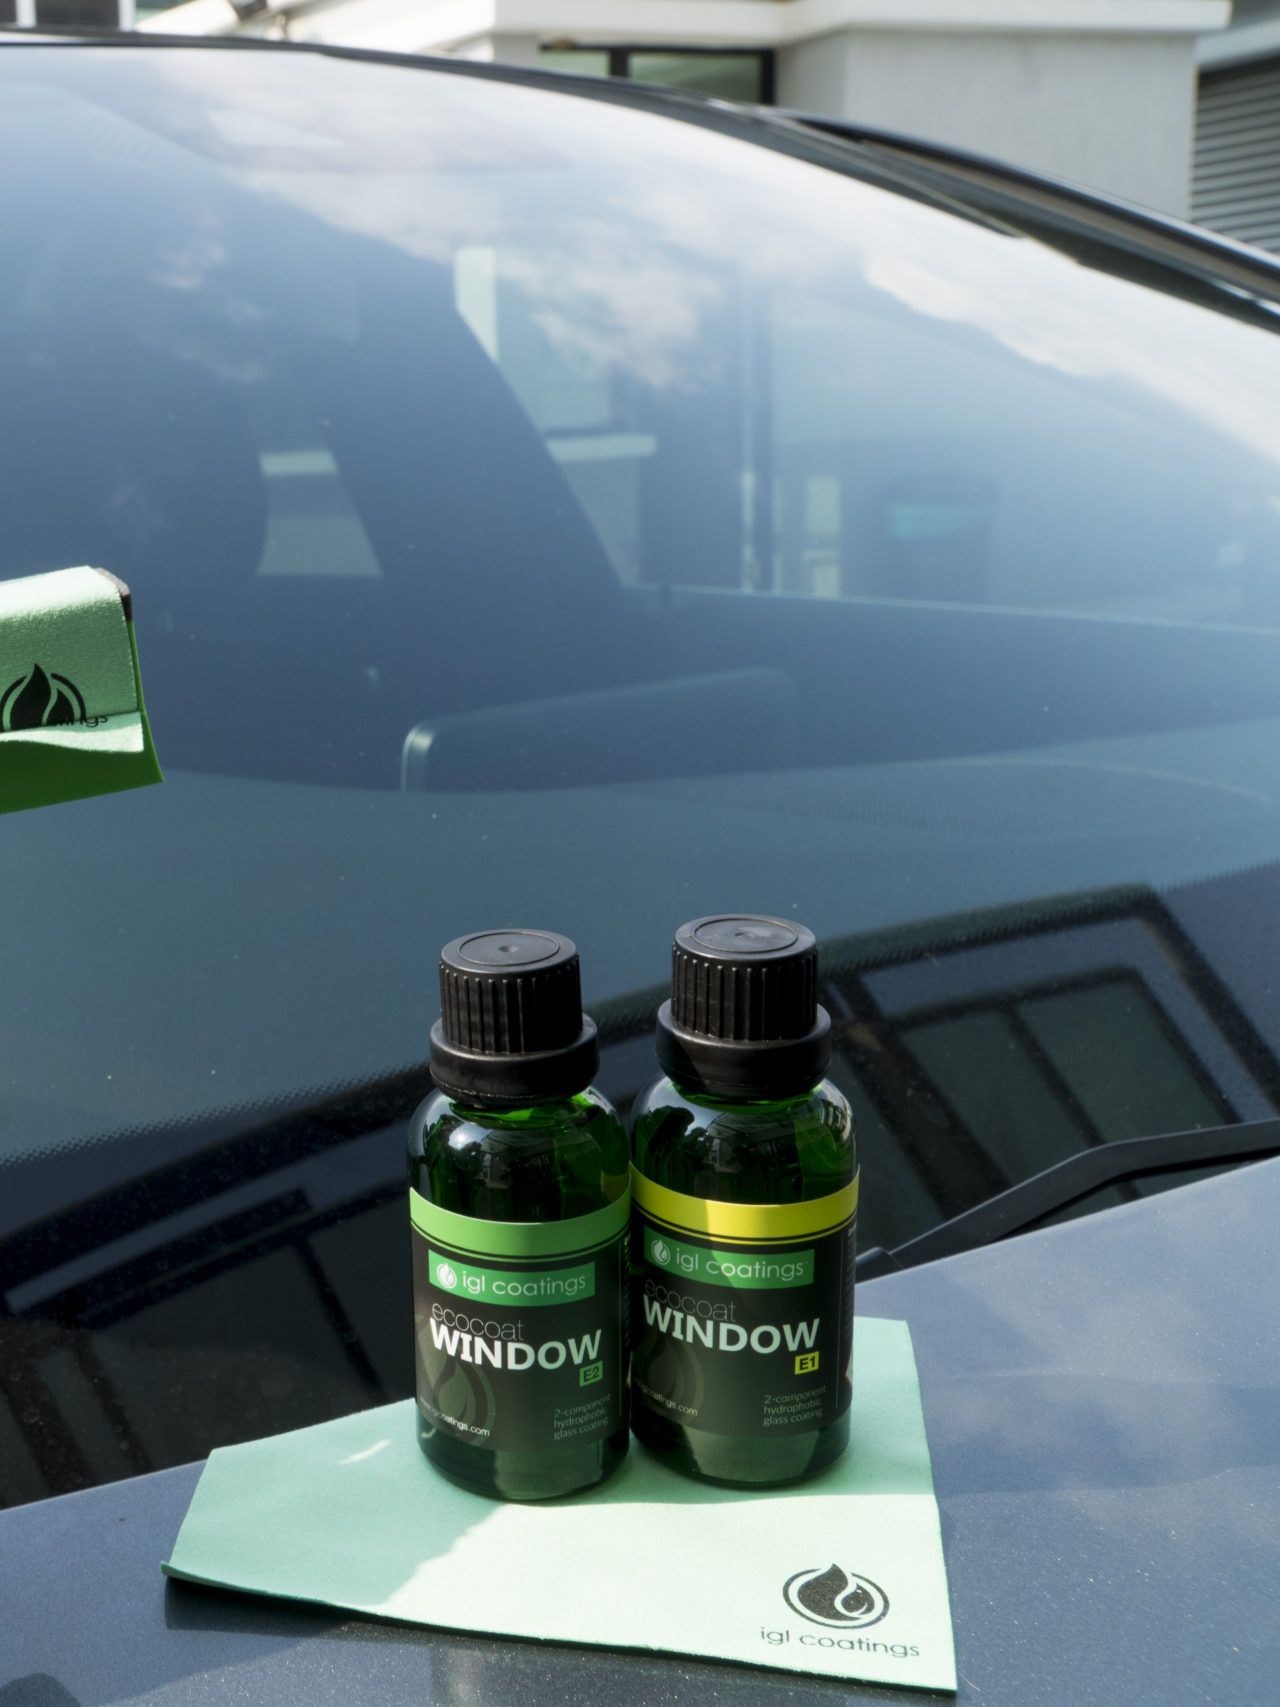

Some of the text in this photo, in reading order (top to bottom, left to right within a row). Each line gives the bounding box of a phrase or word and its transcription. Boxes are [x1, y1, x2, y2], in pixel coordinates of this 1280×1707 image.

[676, 1248, 804, 1281] igl coatings
[462, 1271, 586, 1296] igl coatings
[645, 1279, 737, 1322] ecocoat
[432, 1303, 524, 1341] ecocoat
[643, 1293, 820, 1354] WINDOW
[429, 1317, 602, 1370] WINDOW
[584, 1365, 600, 1381] E2
[799, 1355, 816, 1371] E1
[763, 1398, 823, 1416] hydrophobic
[764, 1385, 826, 1404] 2-component
[763, 1408, 823, 1427] glass coating
[761, 1626, 920, 1659] igl coatings
